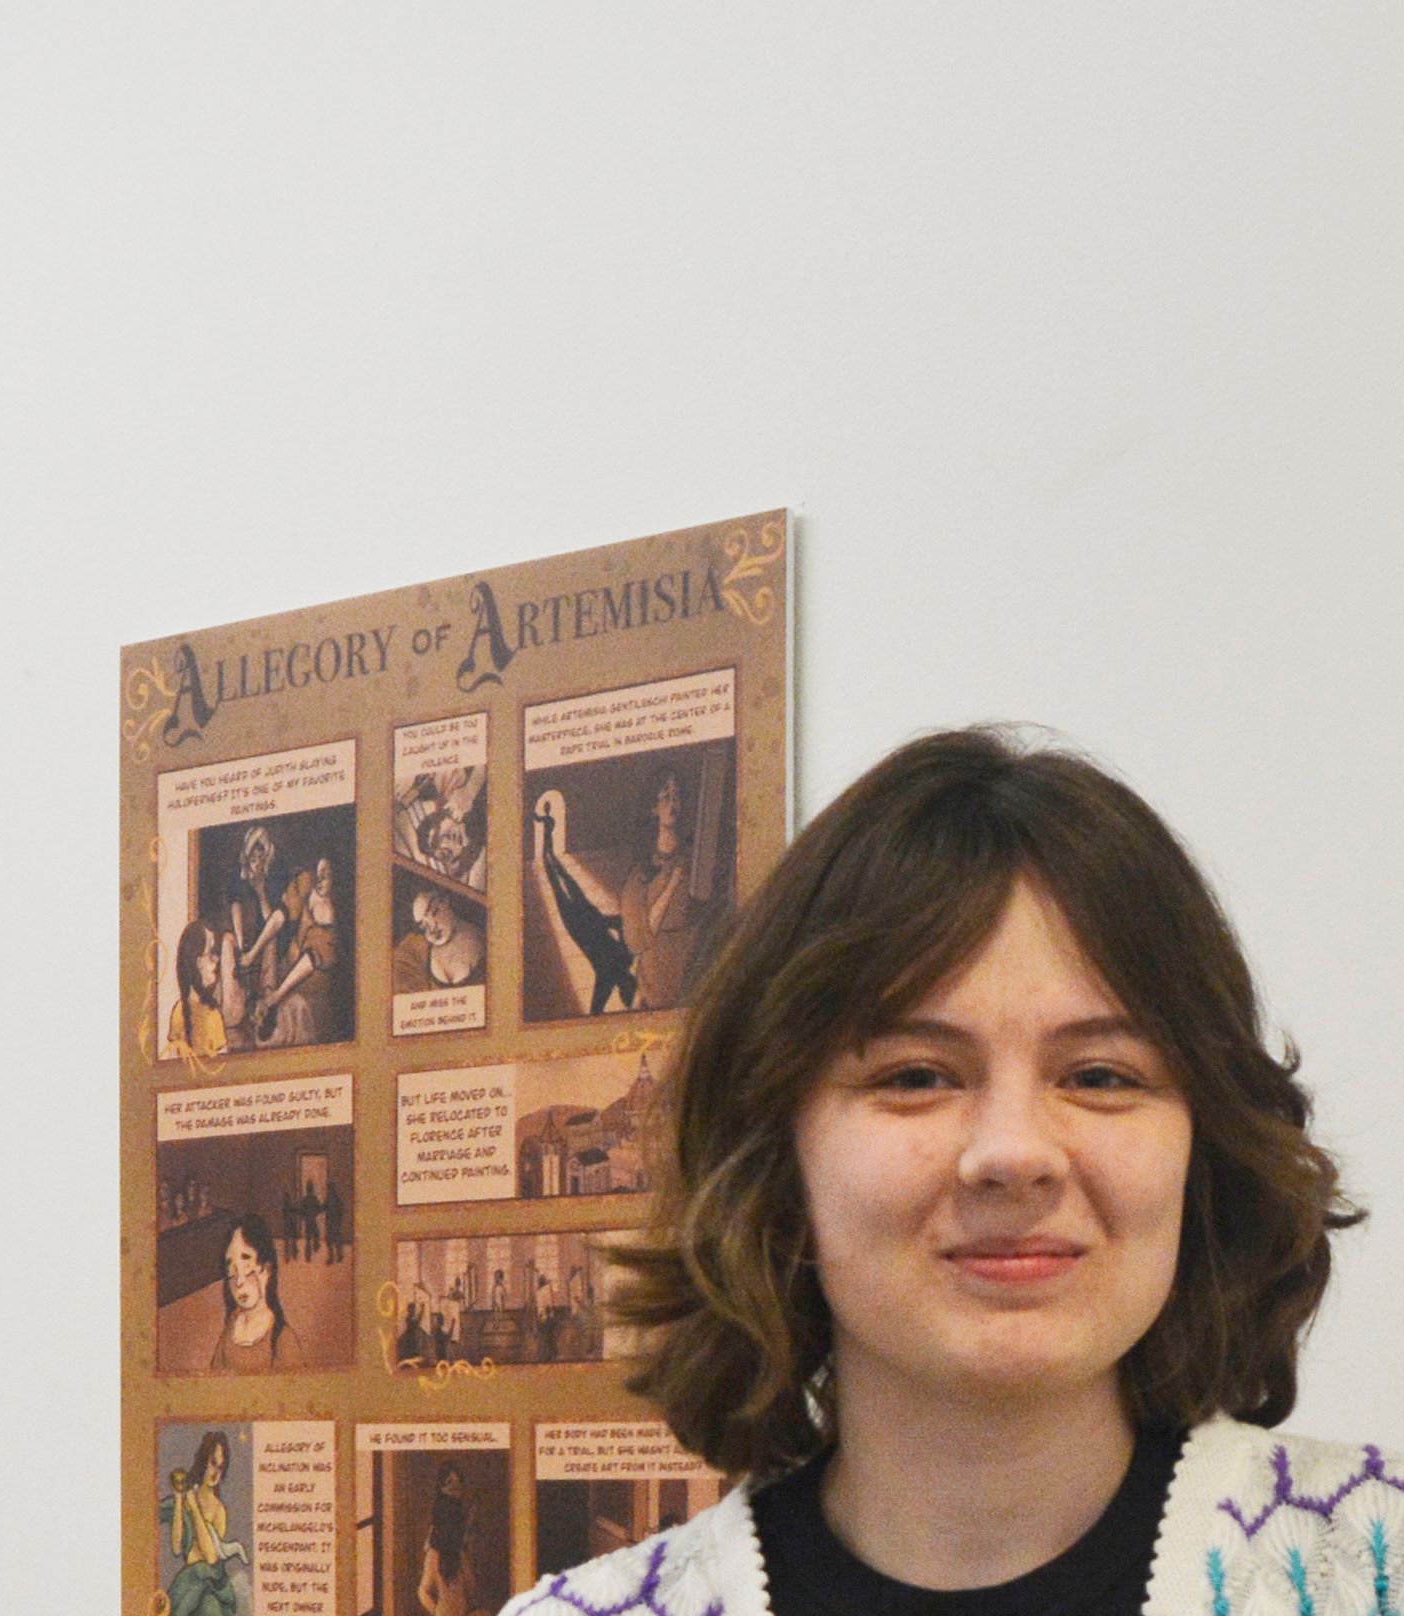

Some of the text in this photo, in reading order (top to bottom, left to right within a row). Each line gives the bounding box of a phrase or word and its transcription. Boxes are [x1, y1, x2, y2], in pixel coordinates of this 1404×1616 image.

[162, 564, 726, 747] ALLEGORY OF ARTEMISIA
